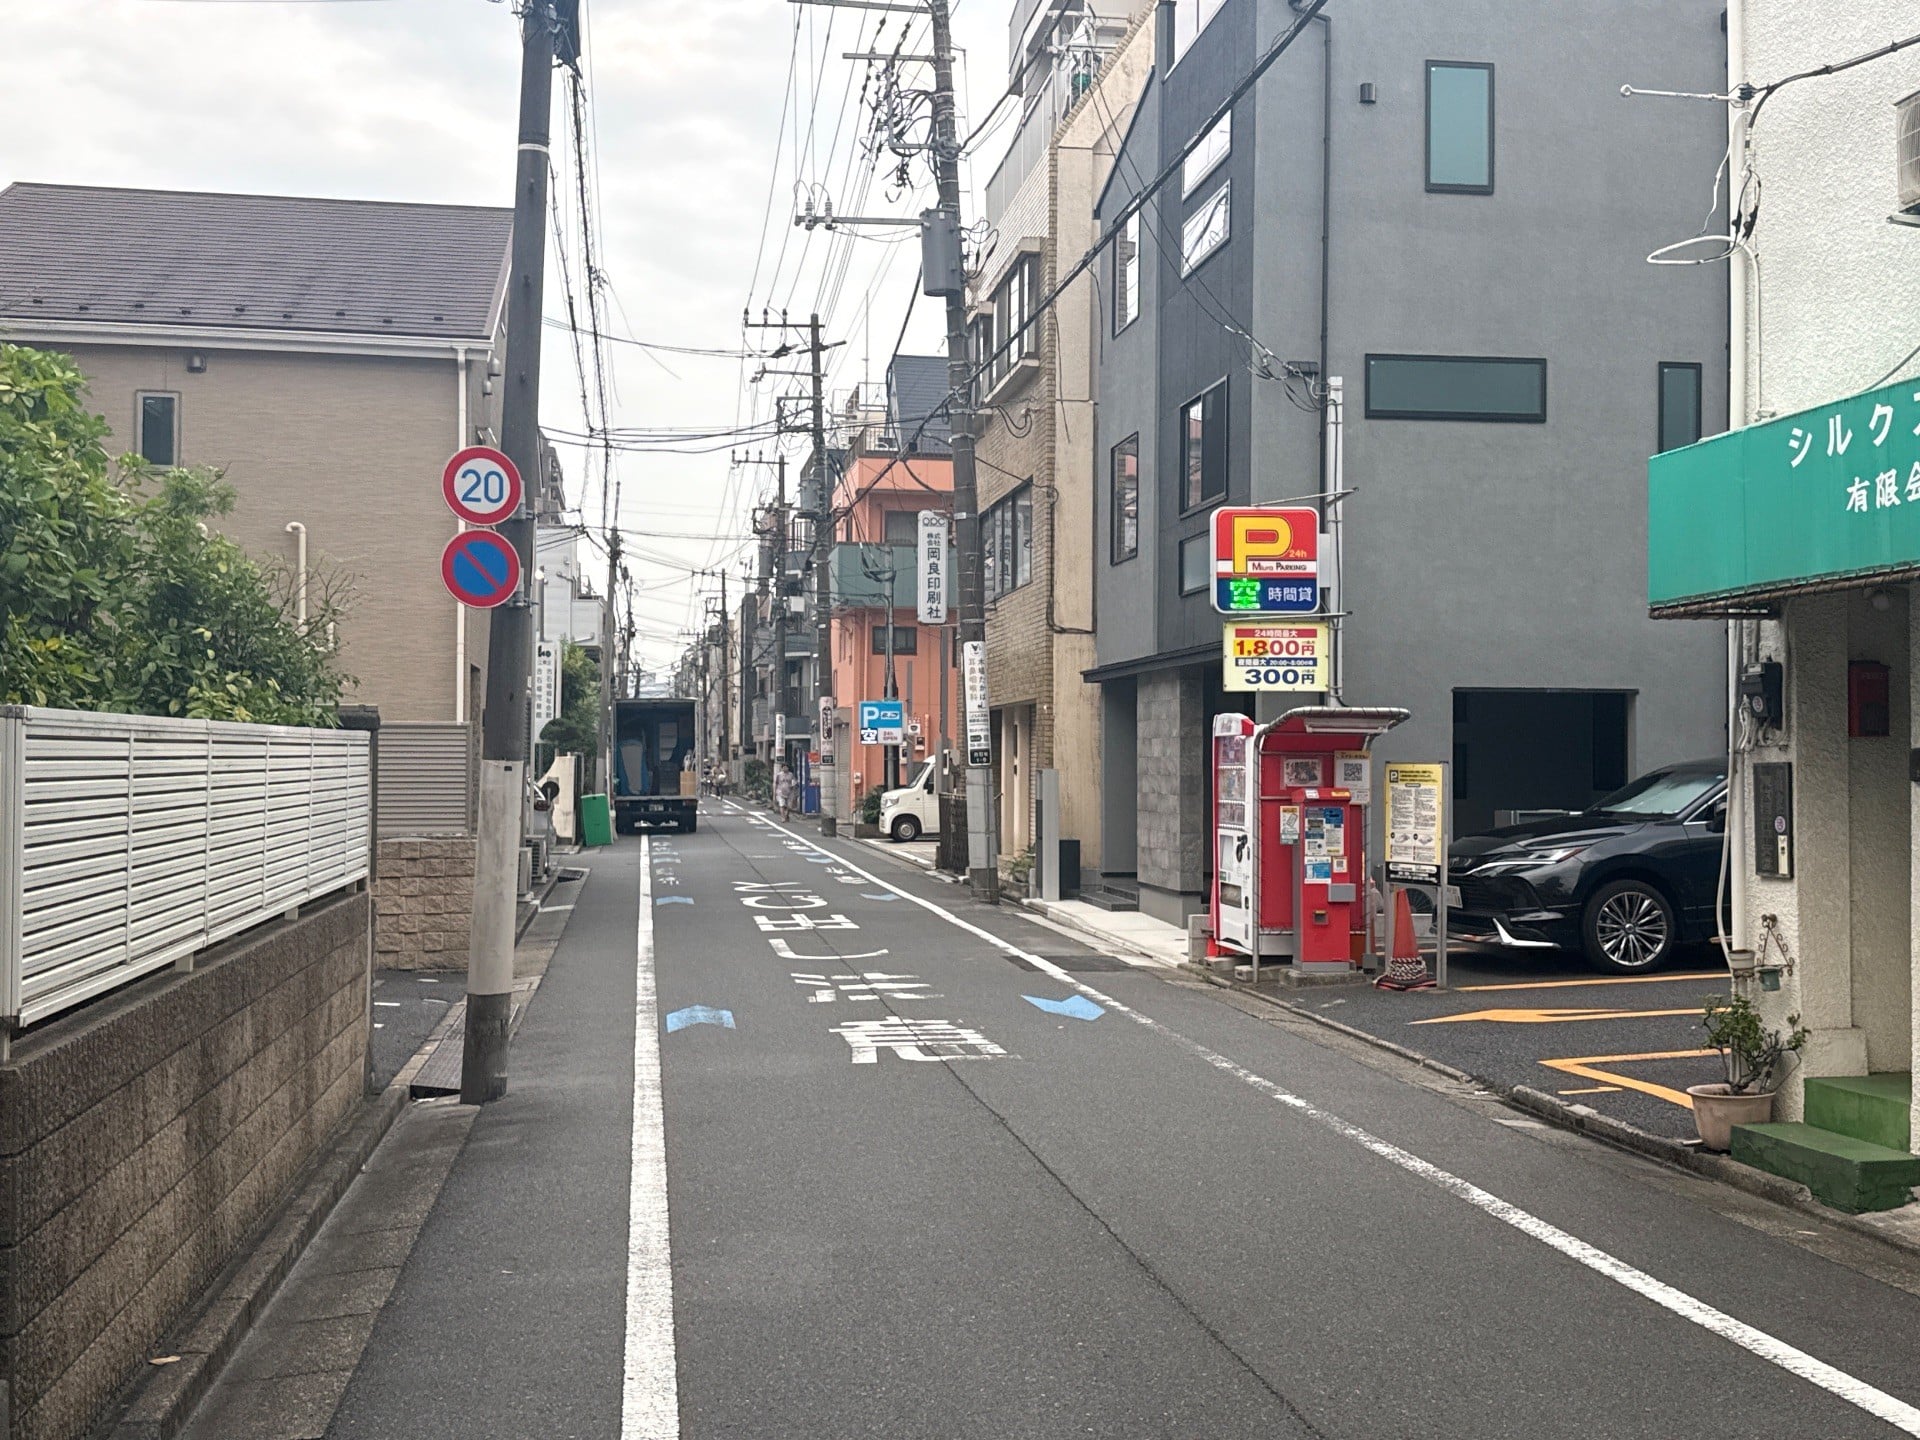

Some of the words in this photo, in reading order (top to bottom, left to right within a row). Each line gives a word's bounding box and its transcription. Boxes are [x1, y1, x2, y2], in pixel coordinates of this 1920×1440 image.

[461, 469, 504, 504] 20
[1233, 516, 1292, 575] P
[1289, 549, 1308, 558] 24h
[926, 547, 942, 619] 岡良印刷社
[1230, 577, 1261, 609] 空
[1268, 587, 1313, 602] 時間貸
[1254, 629, 1298, 637] 24時間最大
[1244, 669, 1315, 685] 300円
[863, 706, 880, 728] P
[861, 728, 878, 745] 空
